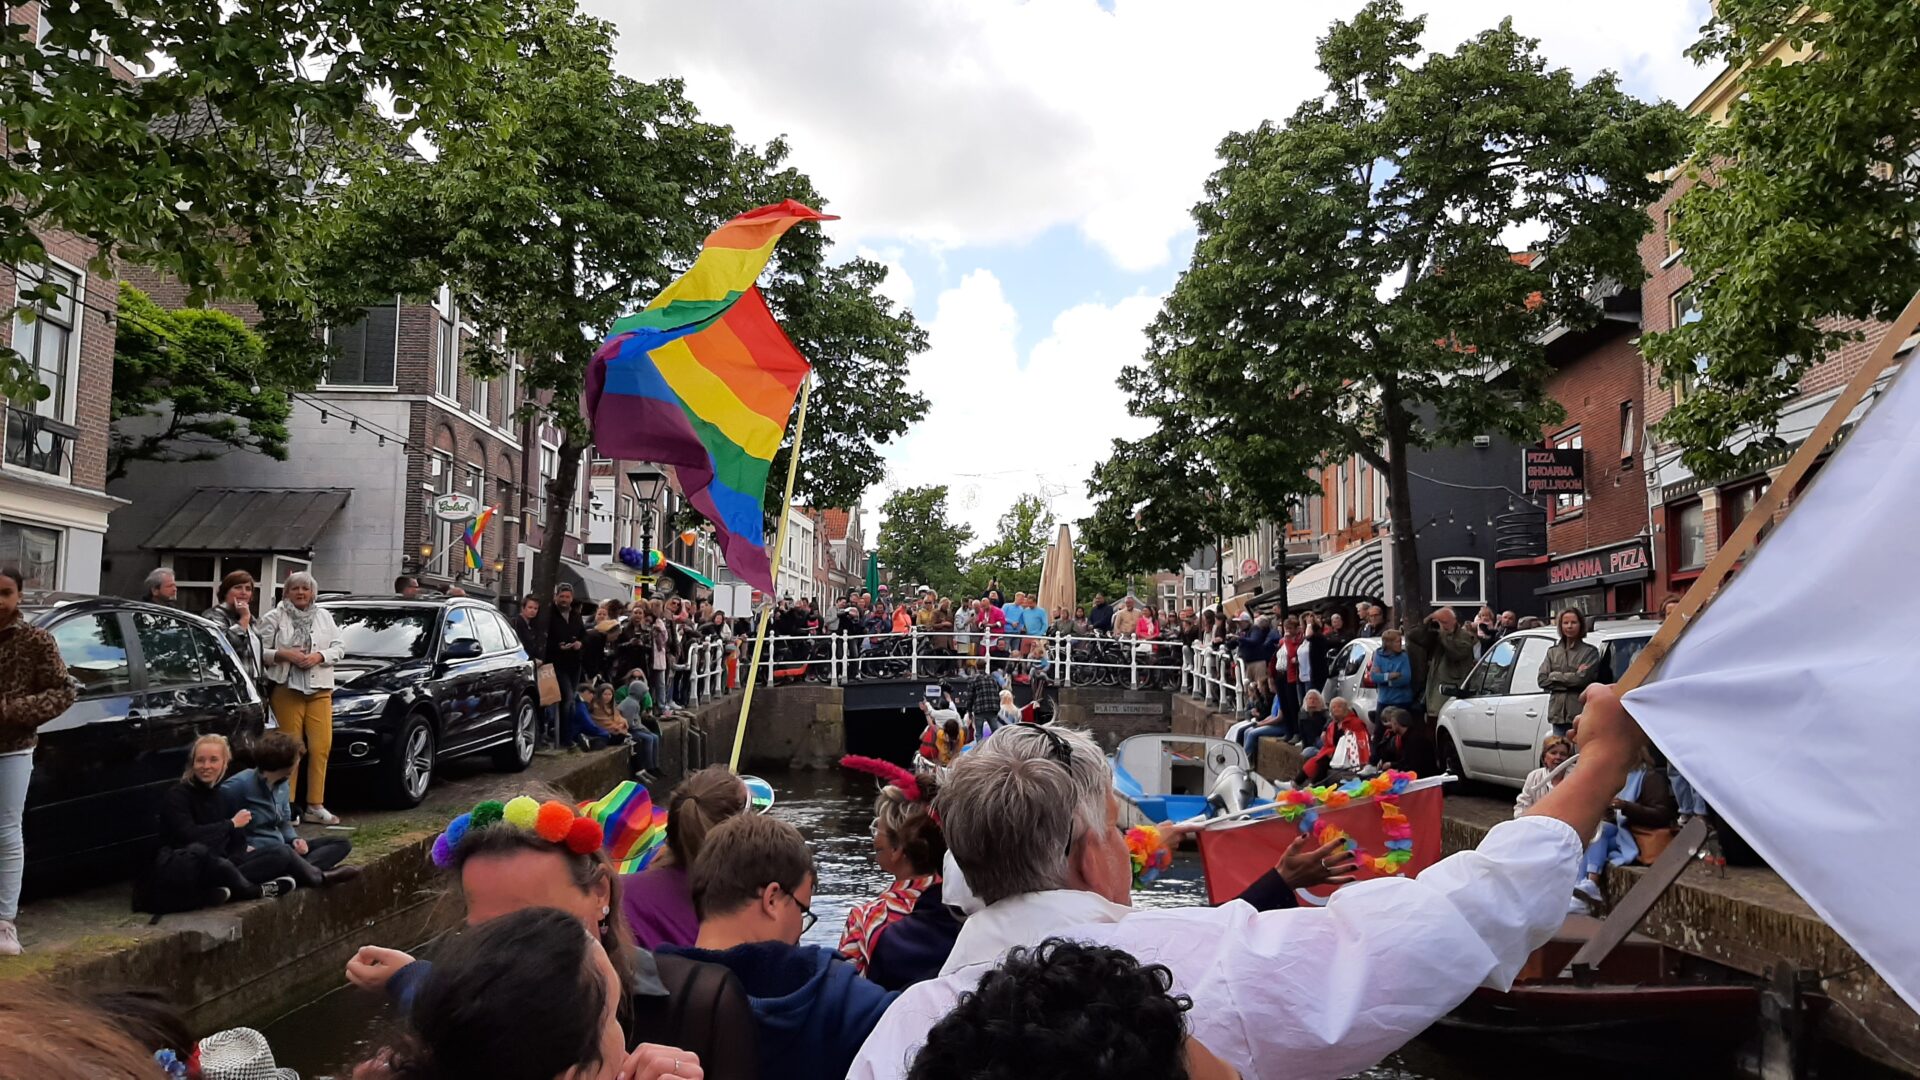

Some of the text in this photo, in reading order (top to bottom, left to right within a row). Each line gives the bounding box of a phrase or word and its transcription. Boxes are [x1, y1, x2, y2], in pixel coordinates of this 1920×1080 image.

[1528, 453, 1555, 463] PIZZA
[1528, 466, 1574, 476] SHOARMA
[1528, 480, 1583, 490] GRILLROOM
[439, 500, 470, 513] Grolsch
[1551, 547, 1648, 583] SHOARMA PIZZA
